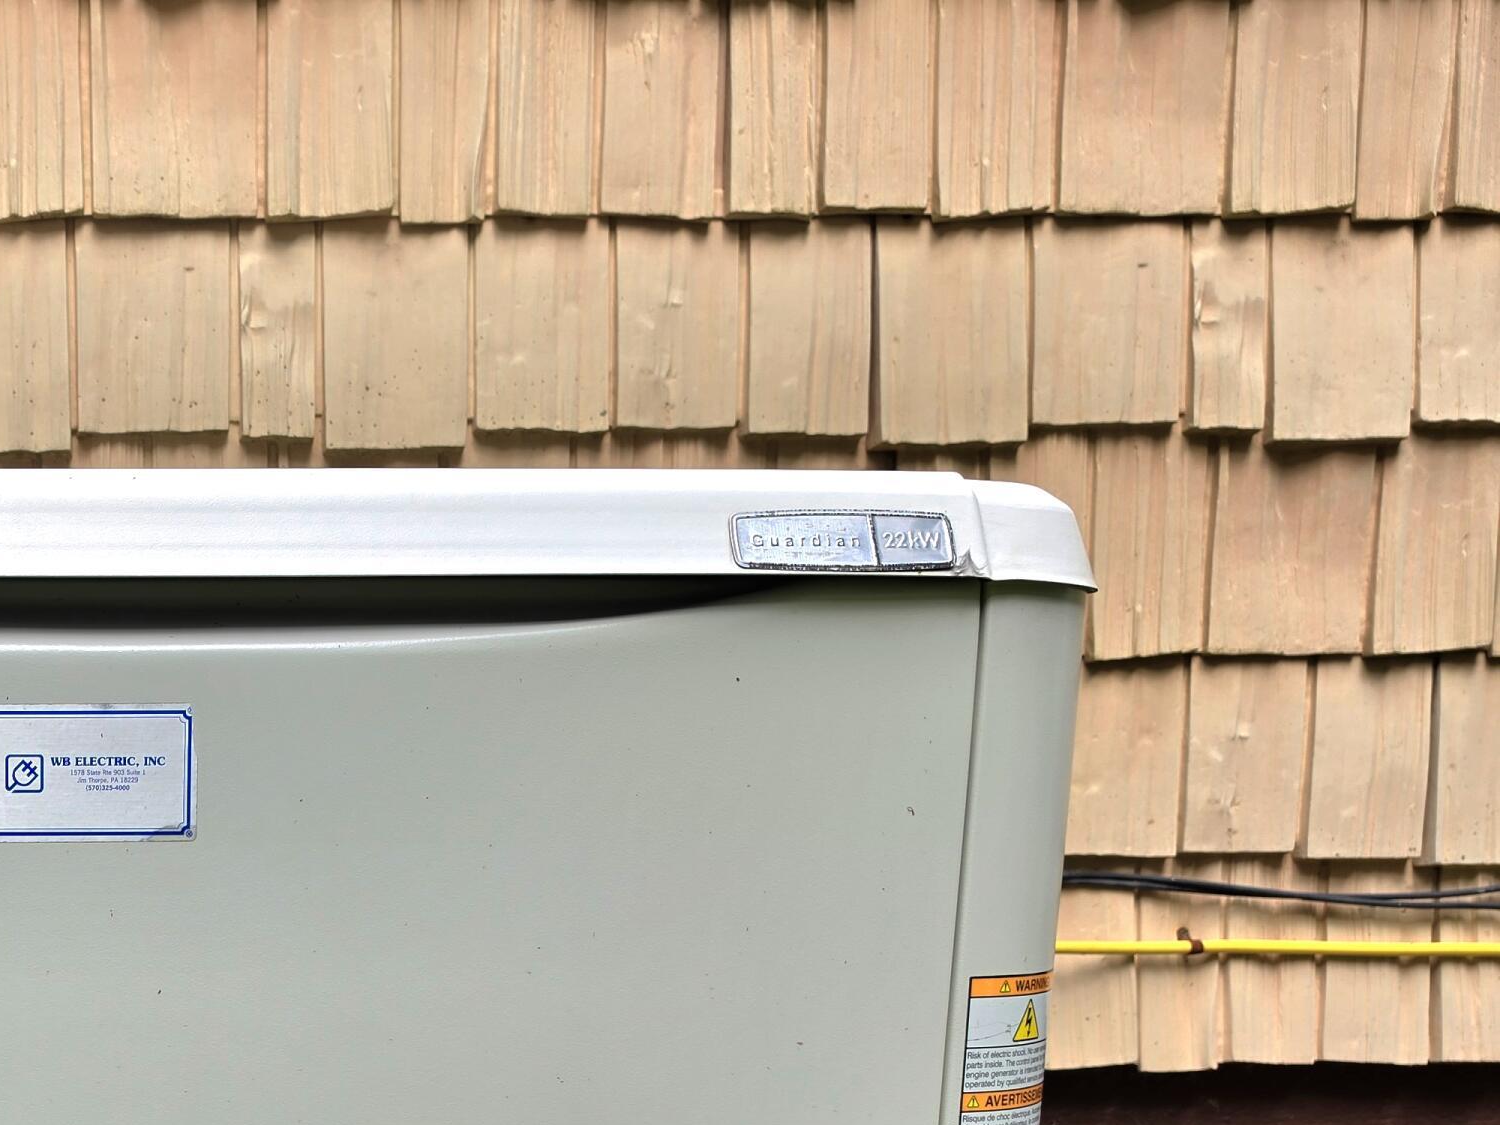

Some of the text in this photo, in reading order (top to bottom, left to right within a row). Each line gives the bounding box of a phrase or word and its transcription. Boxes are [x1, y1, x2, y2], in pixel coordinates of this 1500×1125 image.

[752, 530, 940, 549] Guardian 22kW
[51, 756, 166, 768] WB ELECTRIC, INC
[967, 1051, 981, 1059] Risk
[983, 1051, 989, 1059] of
[991, 1050, 1011, 1058] electric
[966, 1062, 983, 1070] parts
[985, 1060, 1004, 1068] inside.
[966, 1072, 989, 1080] engine
[991, 1070, 1018, 1079] generator
[965, 1080, 995, 1088] operated
[962, 1115, 985, 1124] Risque
